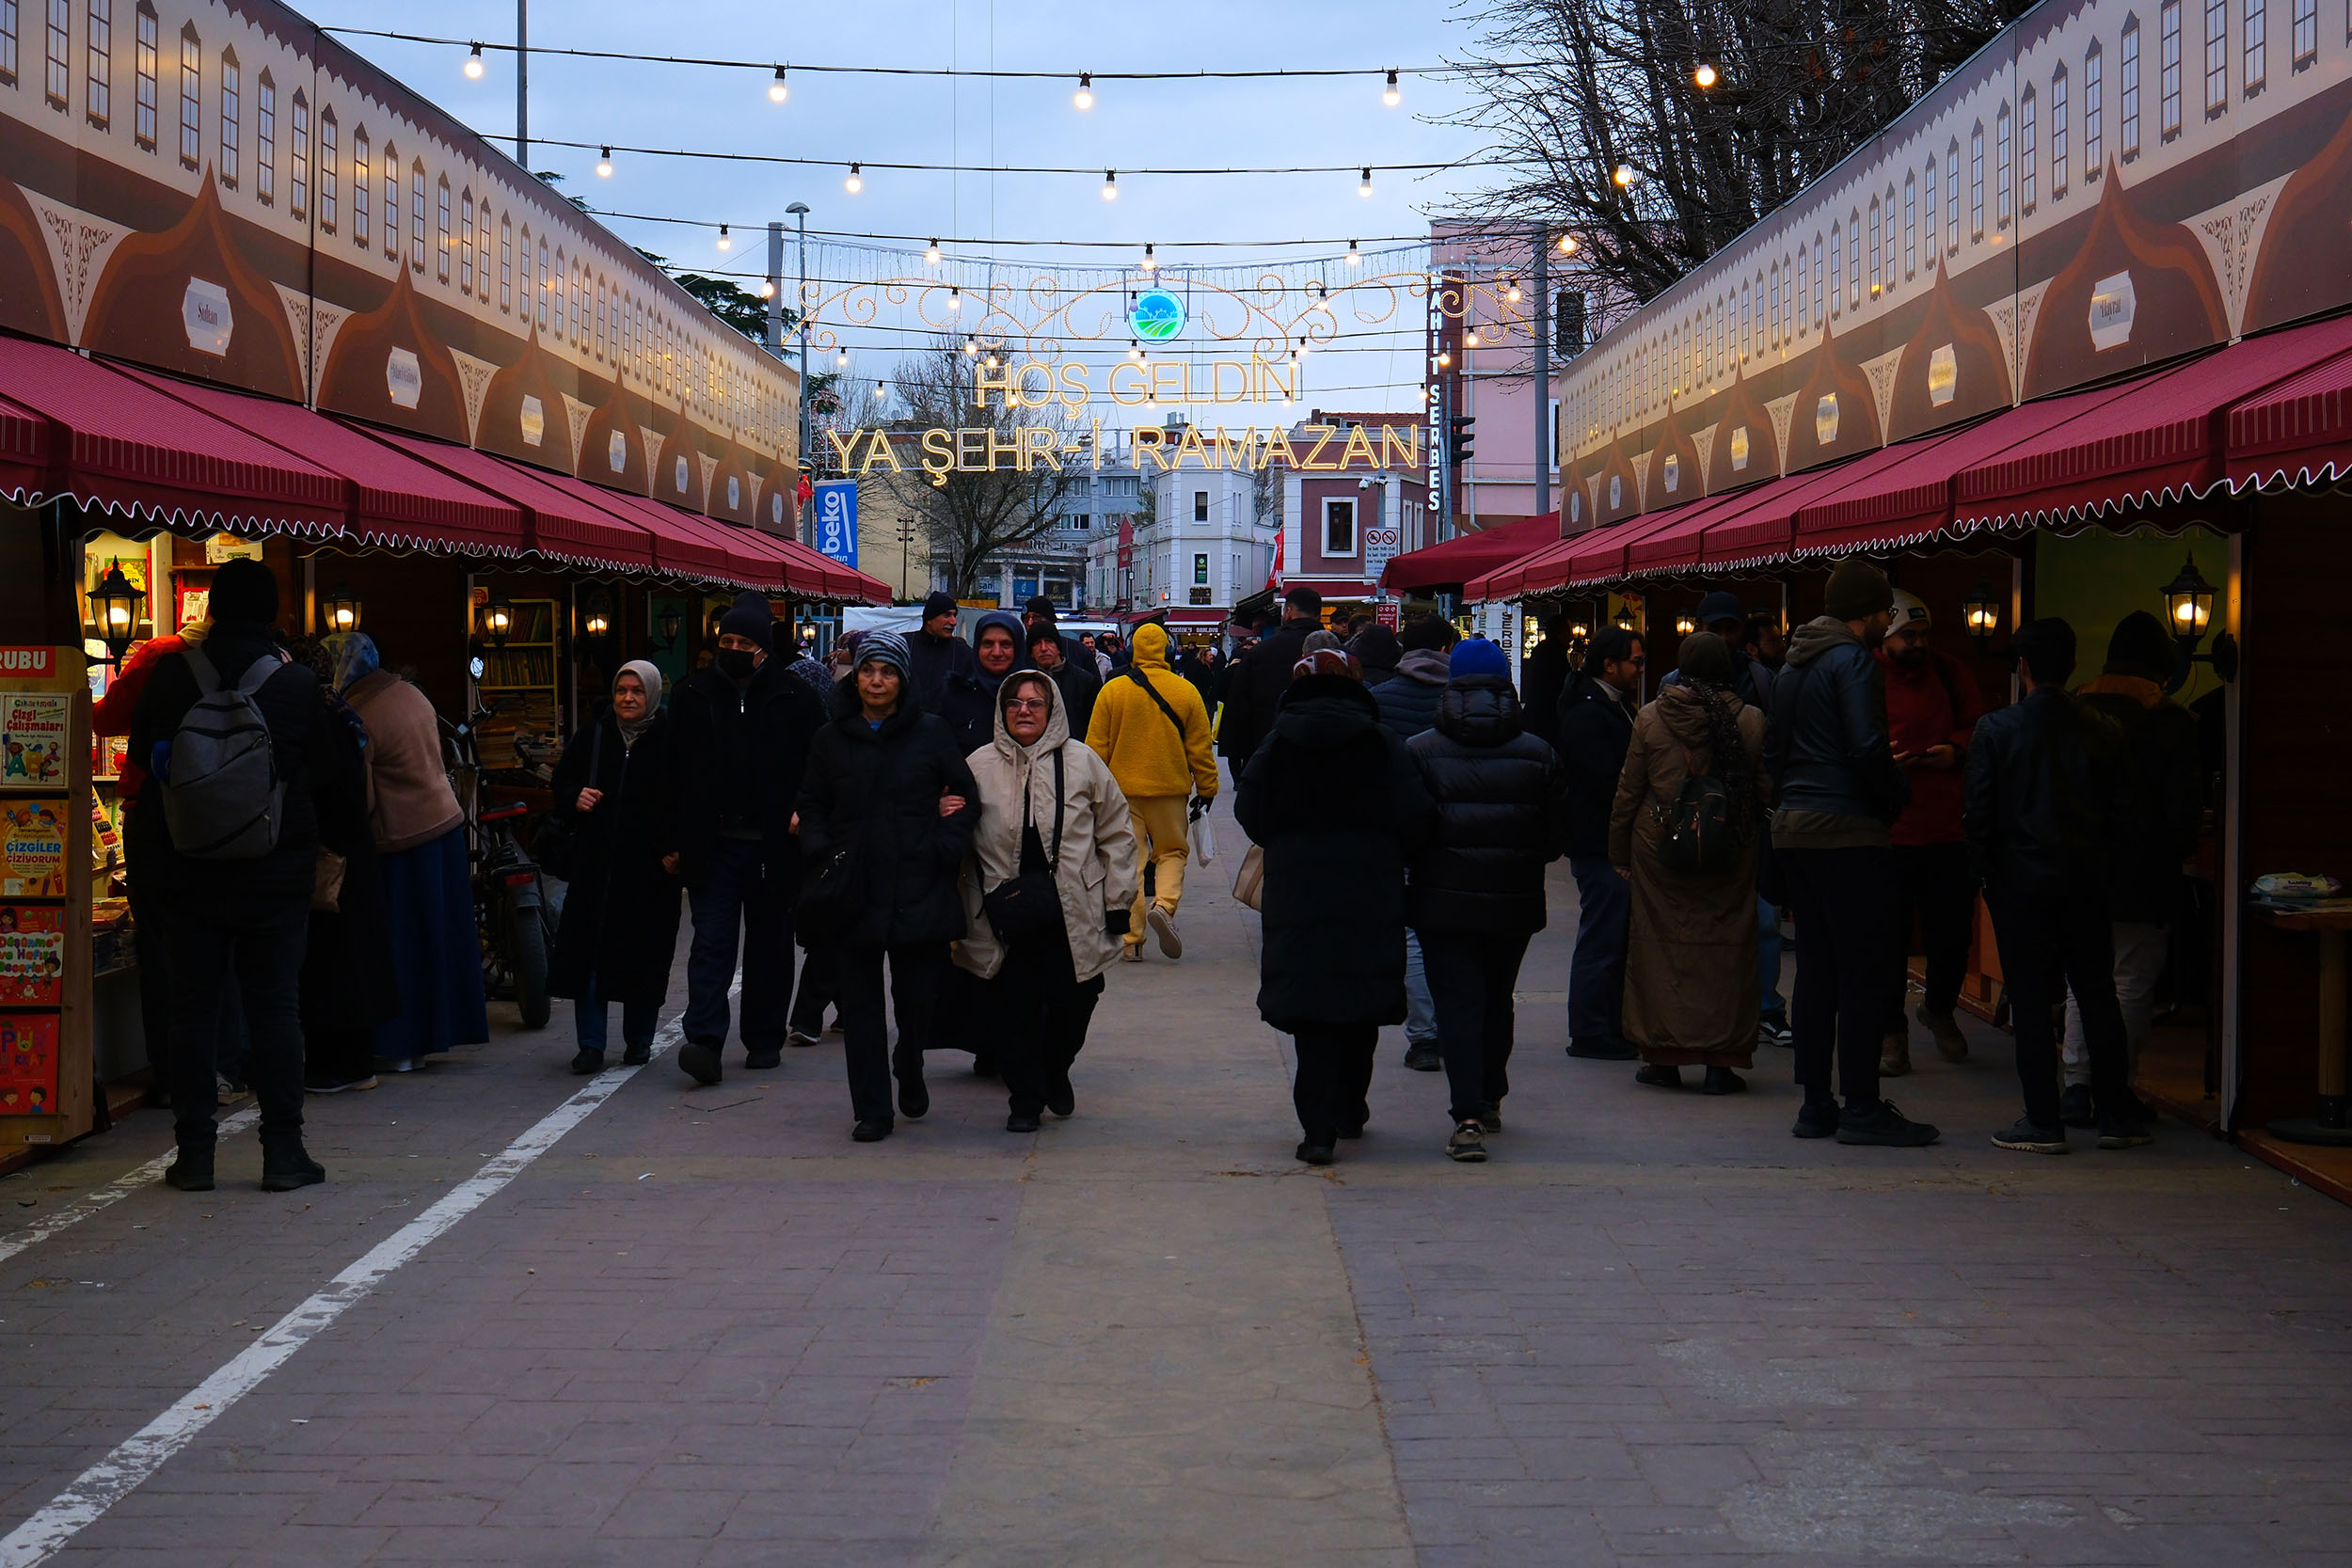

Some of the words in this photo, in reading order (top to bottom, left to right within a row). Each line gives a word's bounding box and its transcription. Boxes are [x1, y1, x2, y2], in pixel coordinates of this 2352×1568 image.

[976, 362, 1090, 420] HOŞ
[1107, 353, 1296, 406] GELDİN
[827, 429, 902, 474] YA
[922, 418, 1100, 486] ŞEHR-İ
[1132, 424, 1419, 470] RAMAZAN
[1428, 385, 1440, 511] SERBES
[821, 491, 841, 554] beko
[0, 650, 46, 670] UBU
[7, 720, 64, 733] Çalışmaları
[7, 838, 61, 854] ÇİZGİLER
